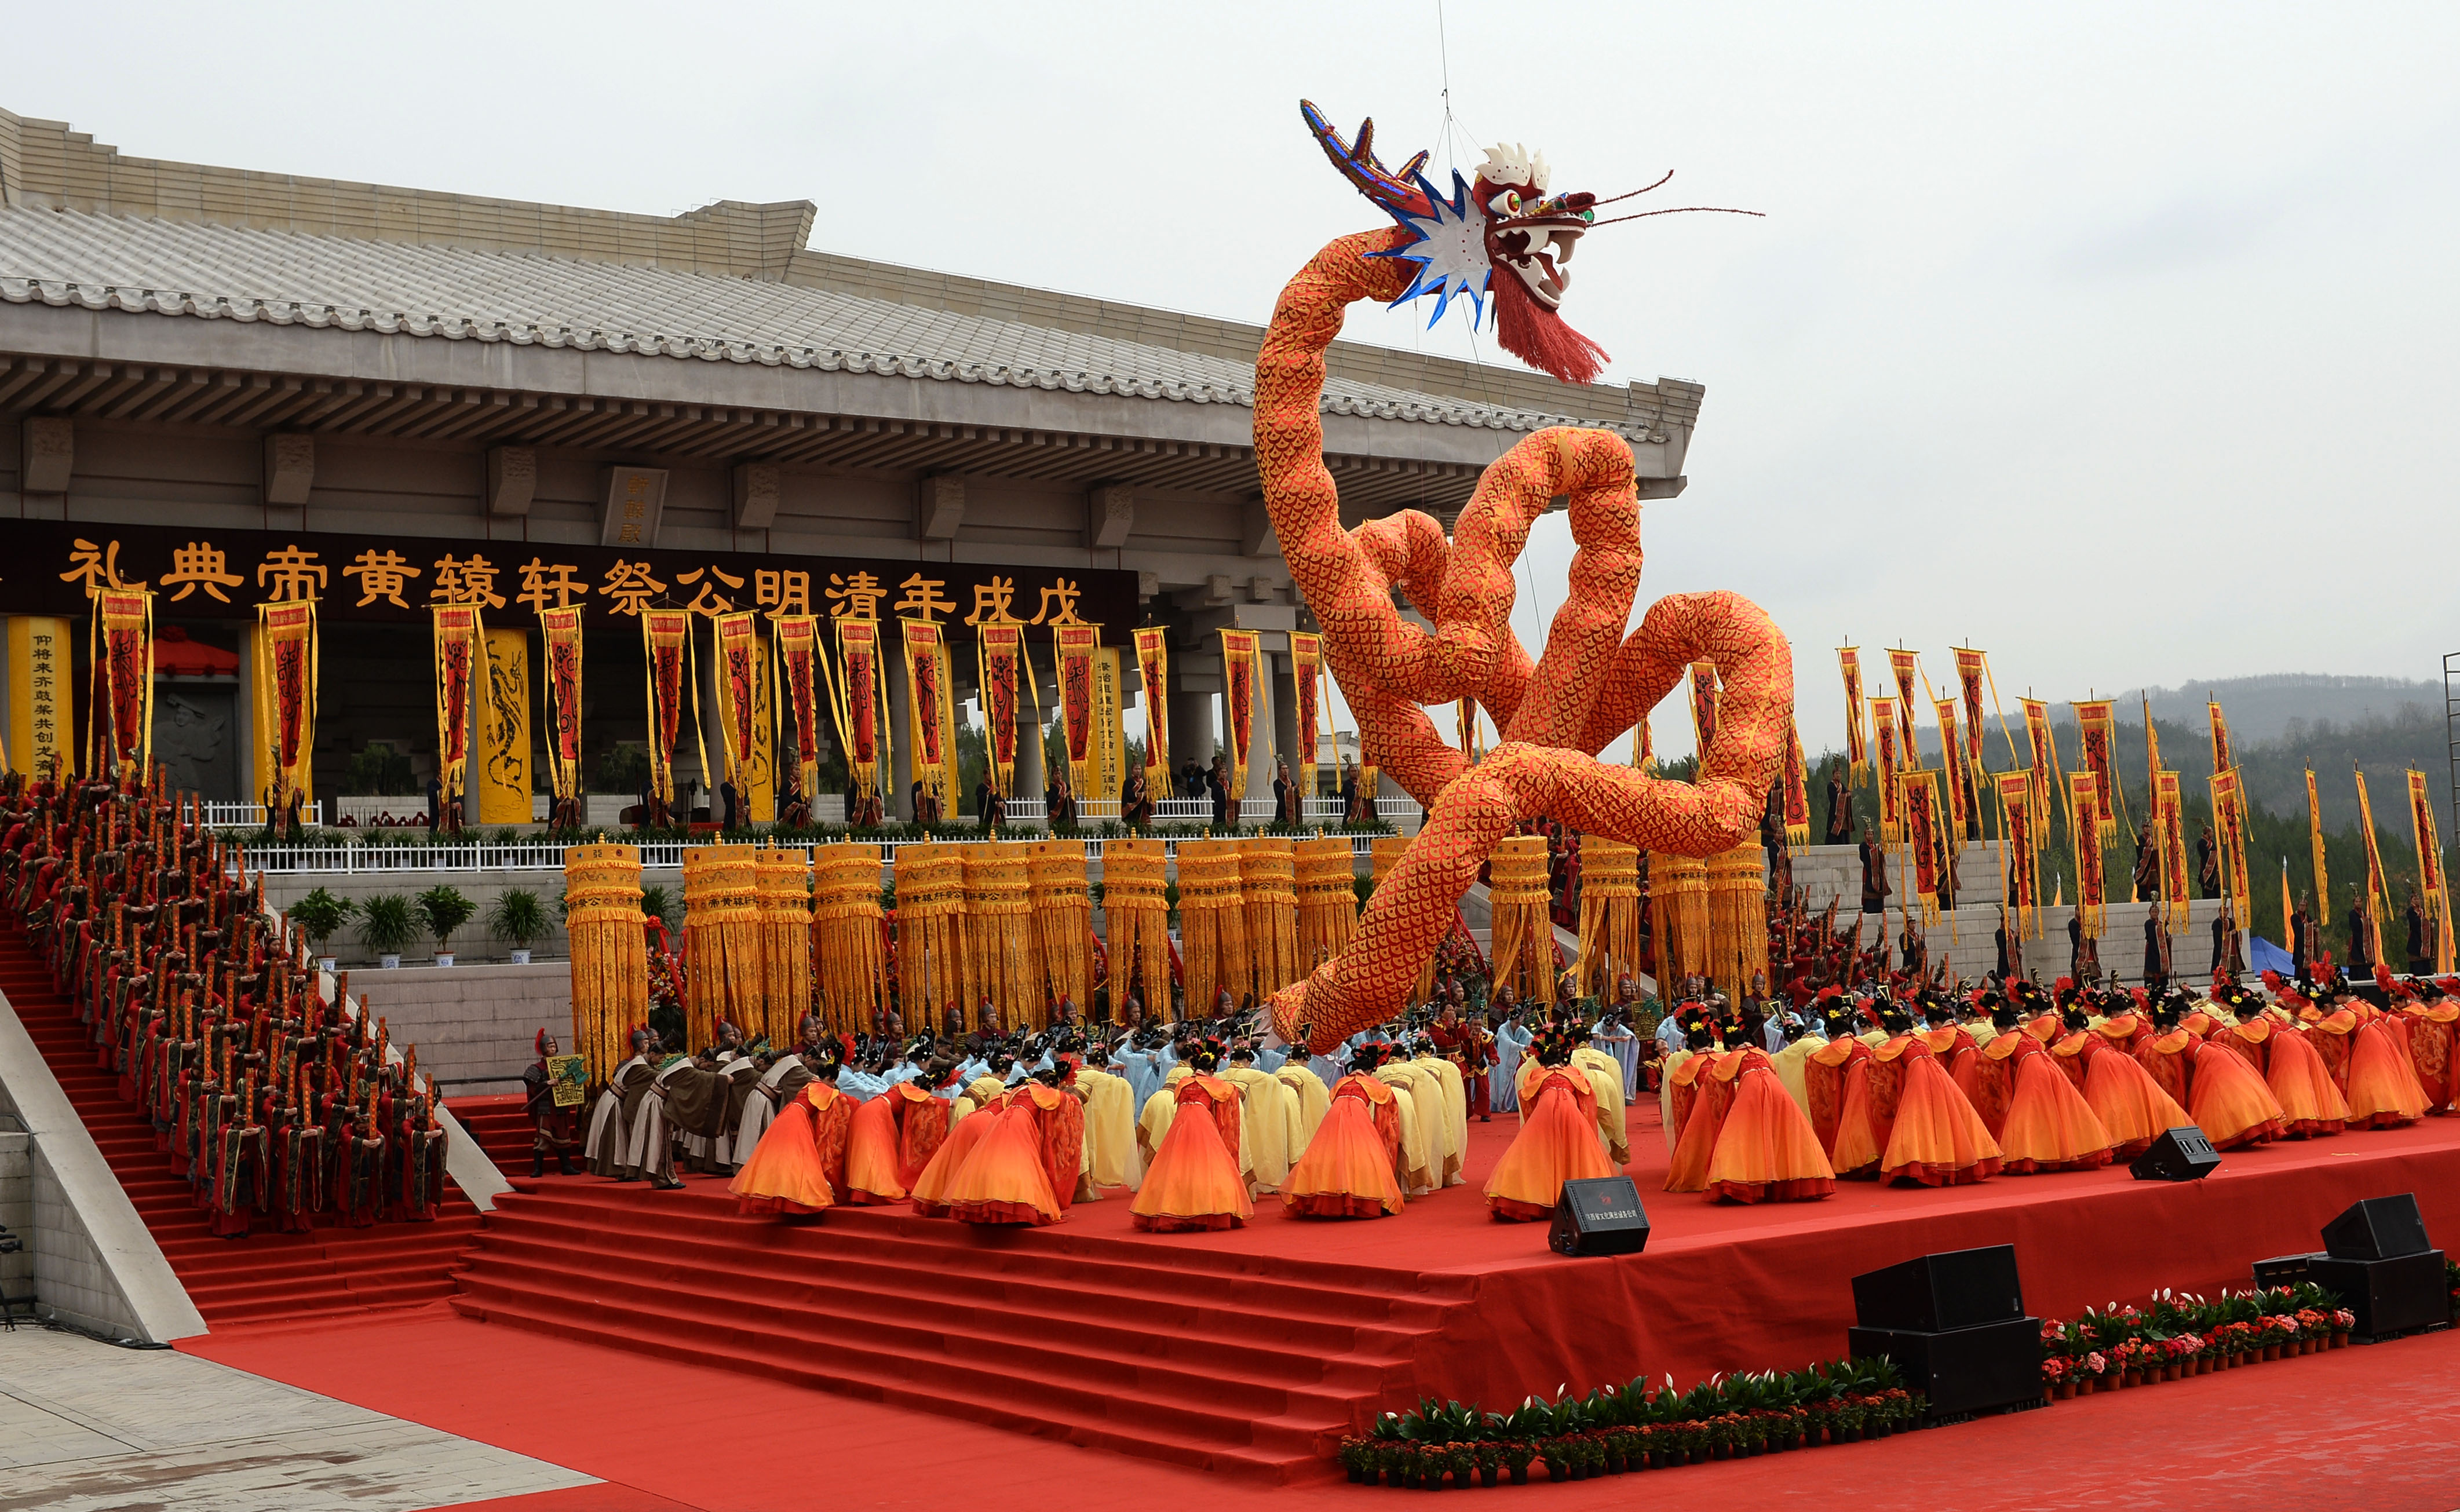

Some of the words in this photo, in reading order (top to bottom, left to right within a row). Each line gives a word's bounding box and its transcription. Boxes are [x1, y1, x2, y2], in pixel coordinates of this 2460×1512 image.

[60, 538, 1089, 626] 戊戌年清明公祭轩辕黄帝典礼
